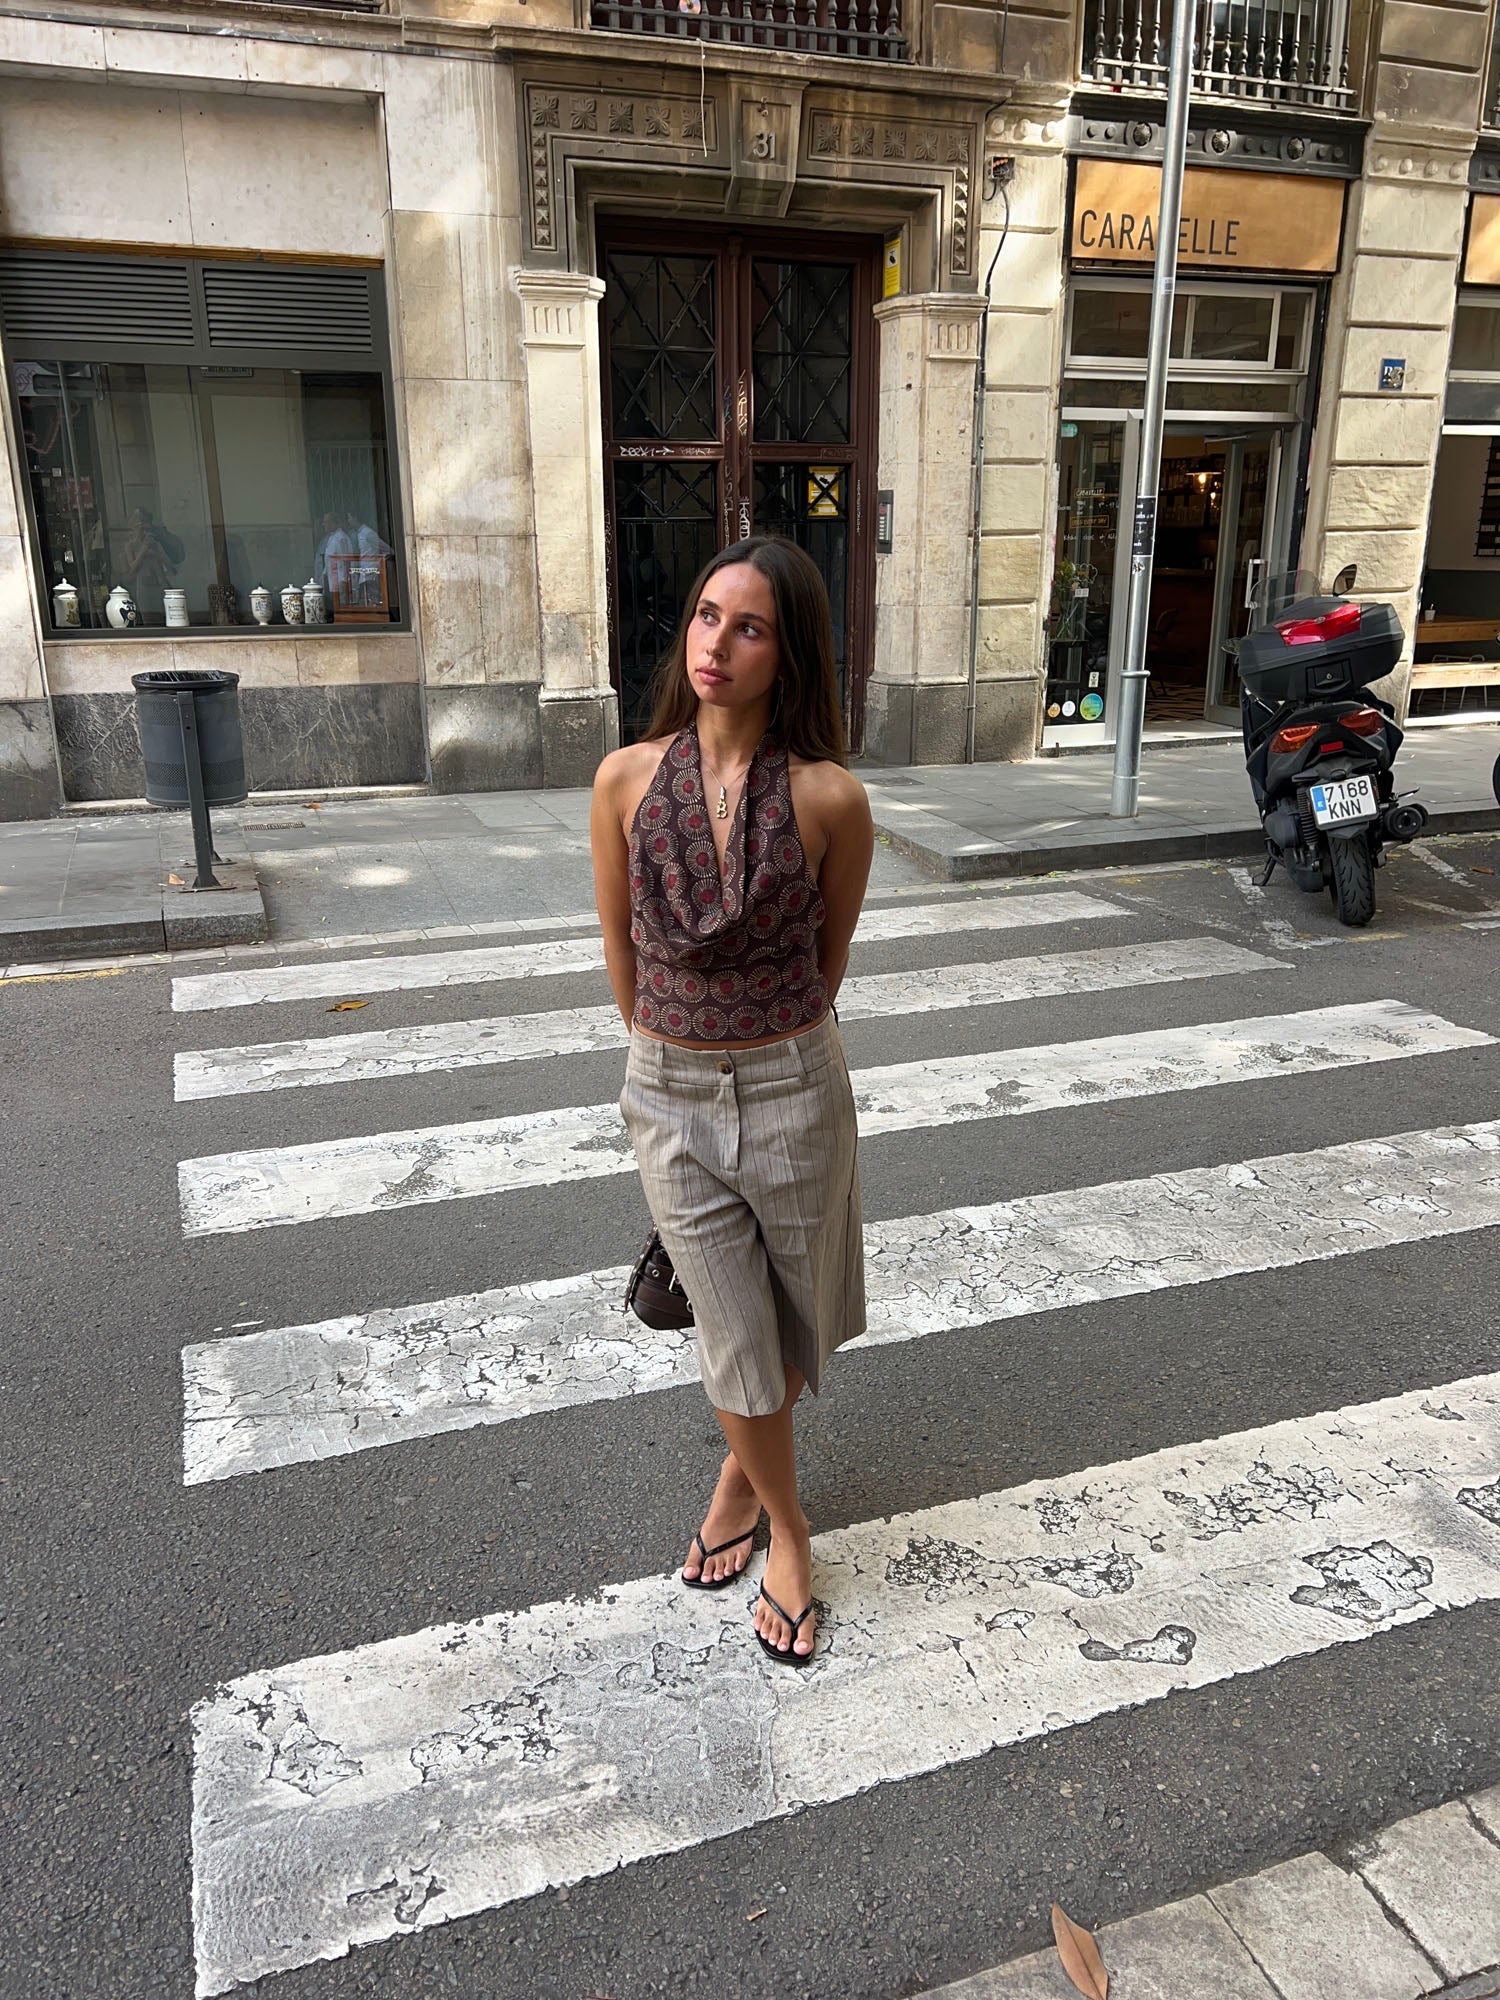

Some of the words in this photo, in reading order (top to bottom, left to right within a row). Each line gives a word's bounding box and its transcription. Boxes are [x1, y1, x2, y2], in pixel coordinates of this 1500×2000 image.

[753, 131, 776, 159] 31
[1080, 209, 1240, 256] CARAELLE
[1325, 780, 1368, 803] 7168
[1328, 798, 1362, 820] KNN
